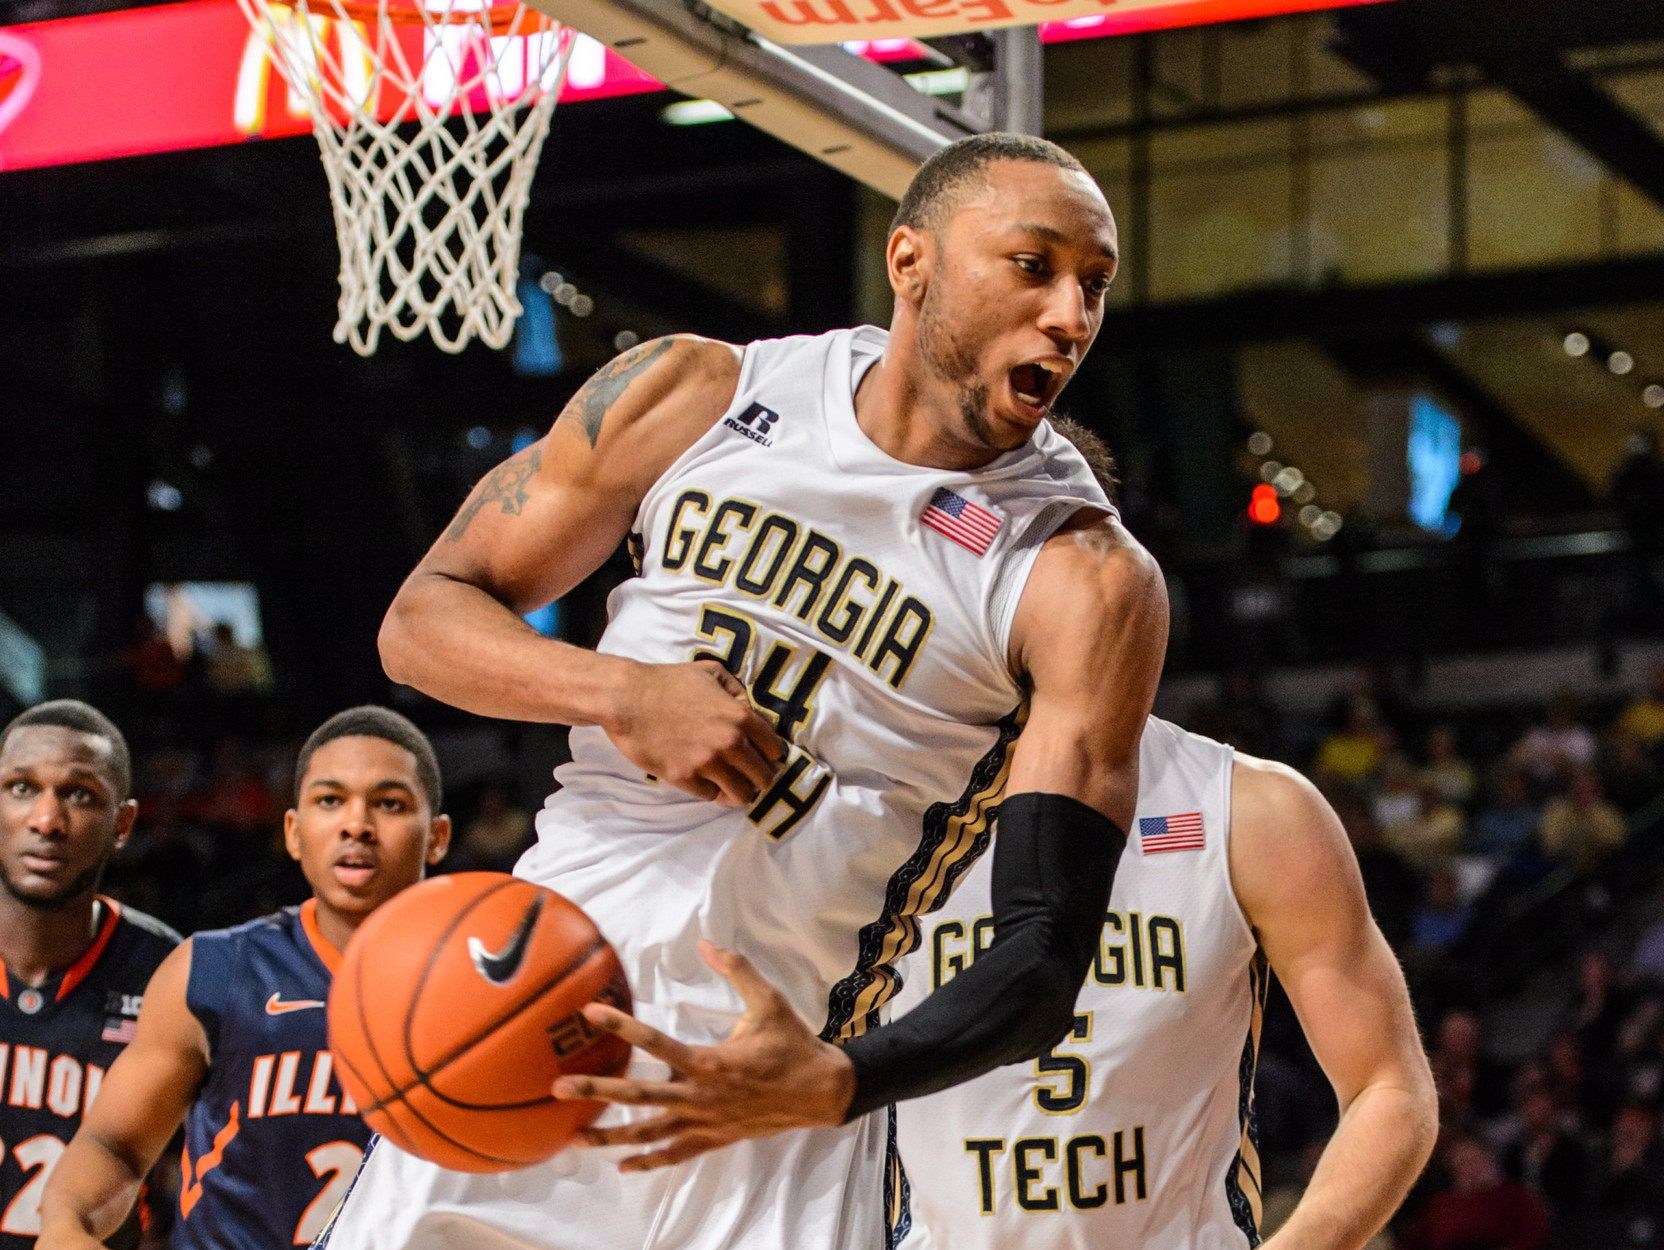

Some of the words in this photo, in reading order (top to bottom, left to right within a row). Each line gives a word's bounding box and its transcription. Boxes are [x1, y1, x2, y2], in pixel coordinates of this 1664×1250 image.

[723, 416, 773, 447] RUSSELL
[661, 488, 935, 690] GEORGIA
[1033, 1011, 1093, 1116] 5
[962, 1124, 1147, 1217] TECH
